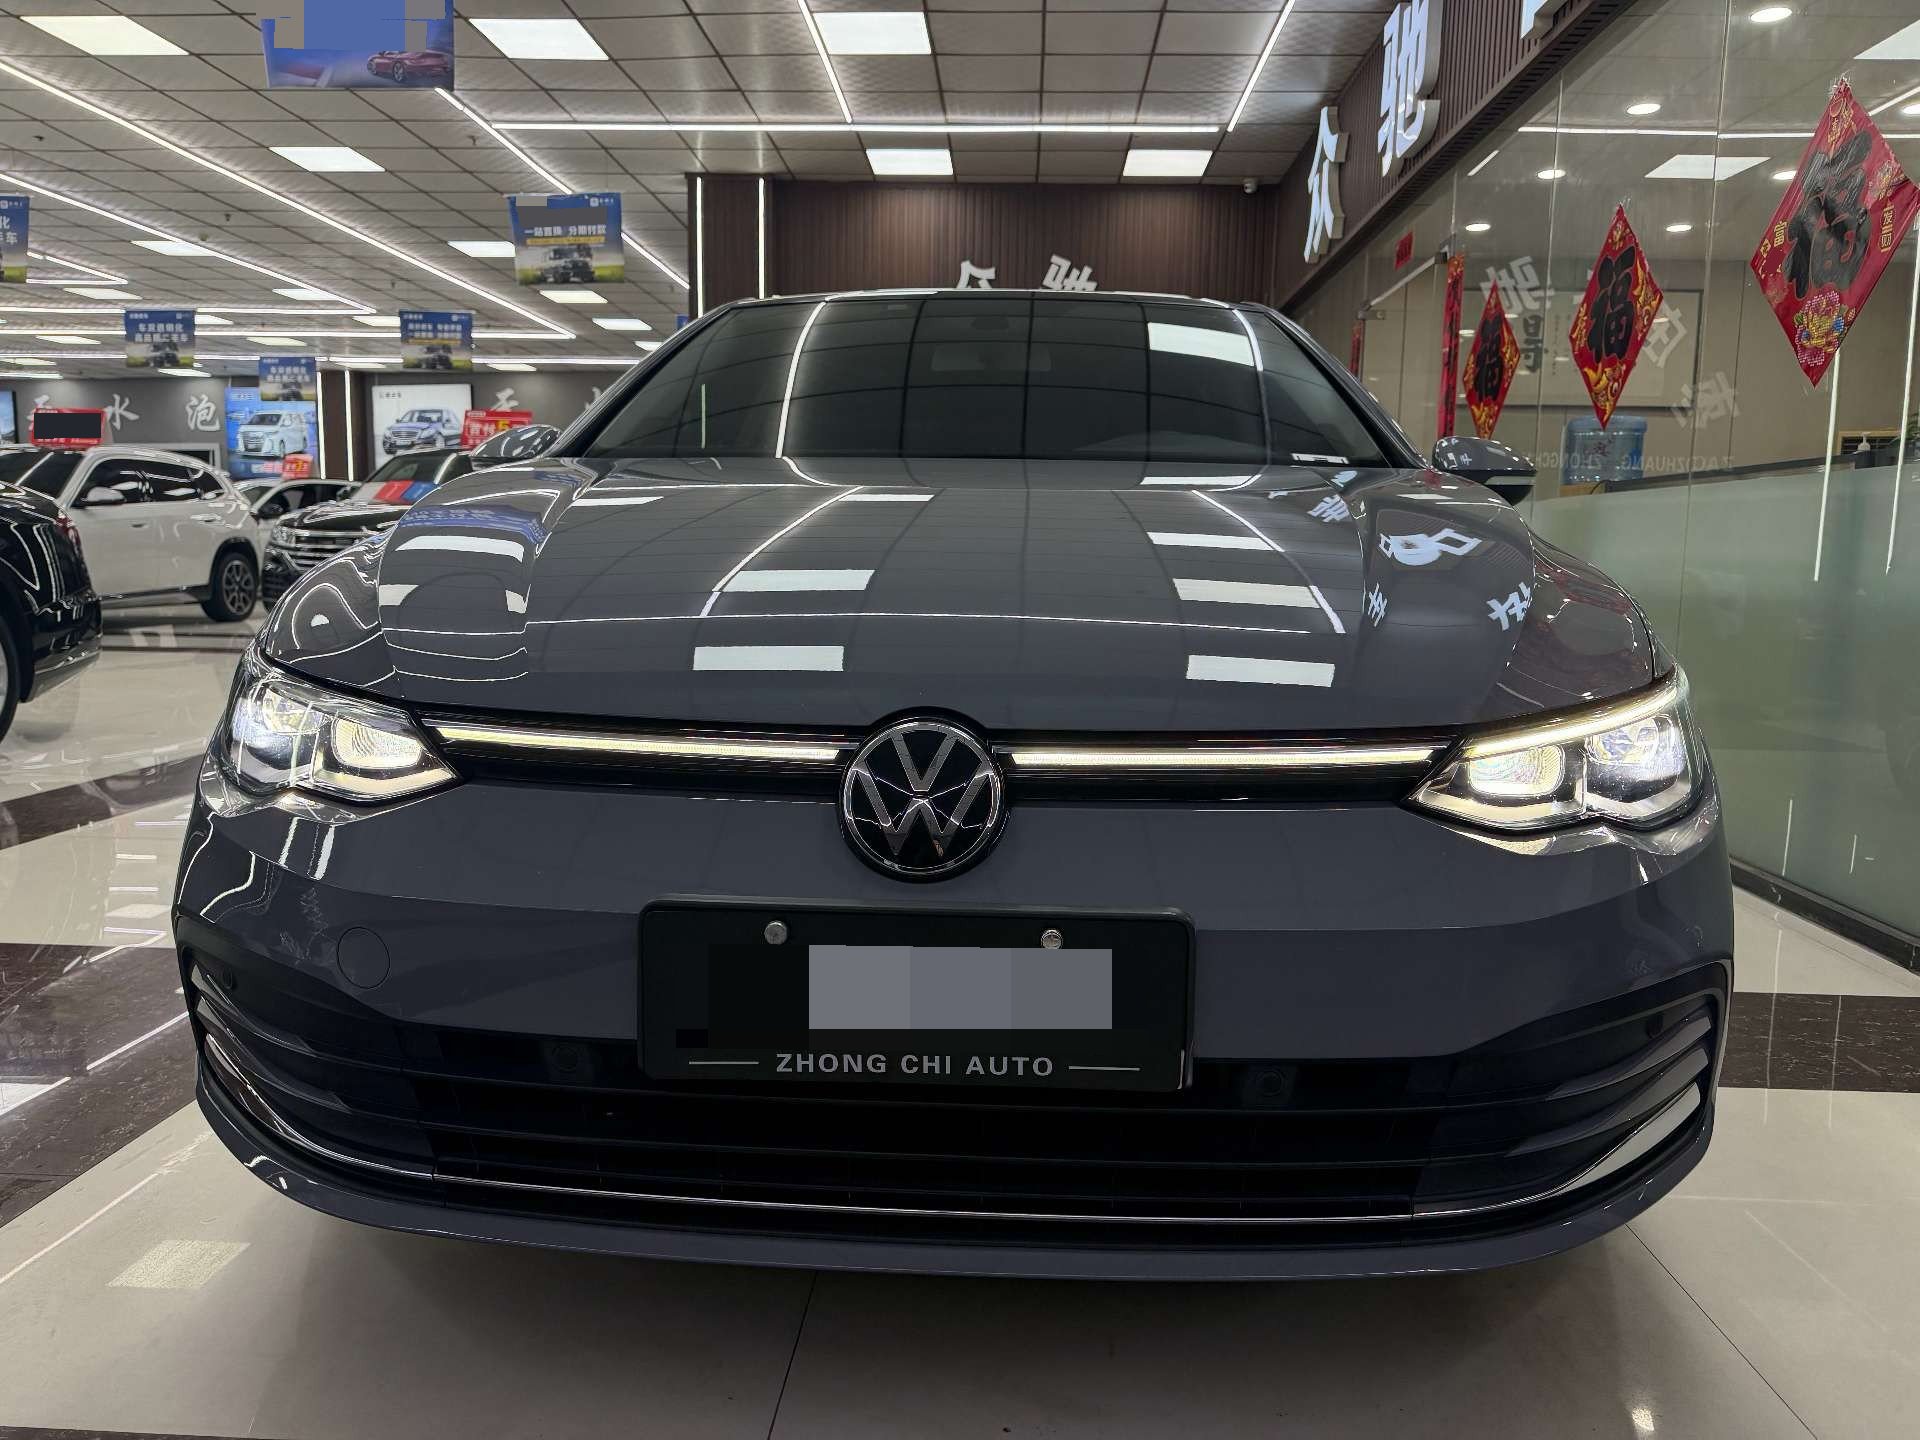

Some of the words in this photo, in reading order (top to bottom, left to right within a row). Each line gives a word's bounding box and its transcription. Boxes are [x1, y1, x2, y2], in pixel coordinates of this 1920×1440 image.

[1784, 129, 1872, 299] 福
[1587, 246, 1636, 363] 福
[1475, 313, 1504, 400] 福
[776, 1053, 887, 1074] ZHONG
[900, 1054, 951, 1075] CHI
[965, 1055, 1053, 1076] AUTO
